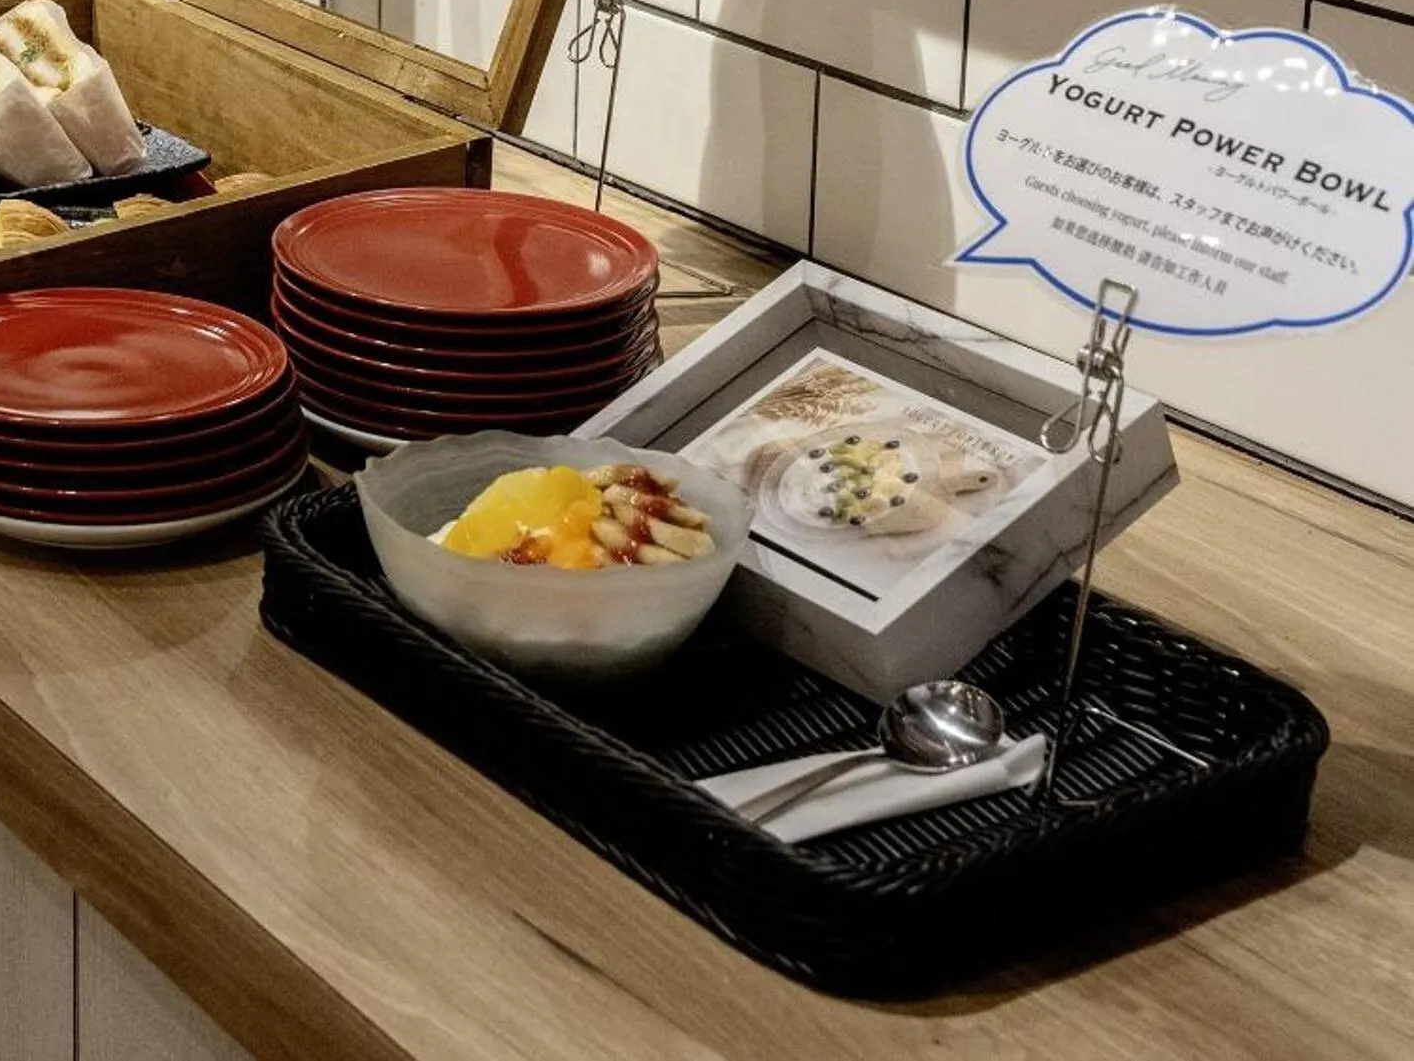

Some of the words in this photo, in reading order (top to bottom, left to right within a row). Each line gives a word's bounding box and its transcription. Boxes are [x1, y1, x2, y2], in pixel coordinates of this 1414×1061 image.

[1047, 73, 1165, 130] YOGURT
[1170, 117, 1285, 174] POWER
[1293, 158, 1391, 214] BOWL
